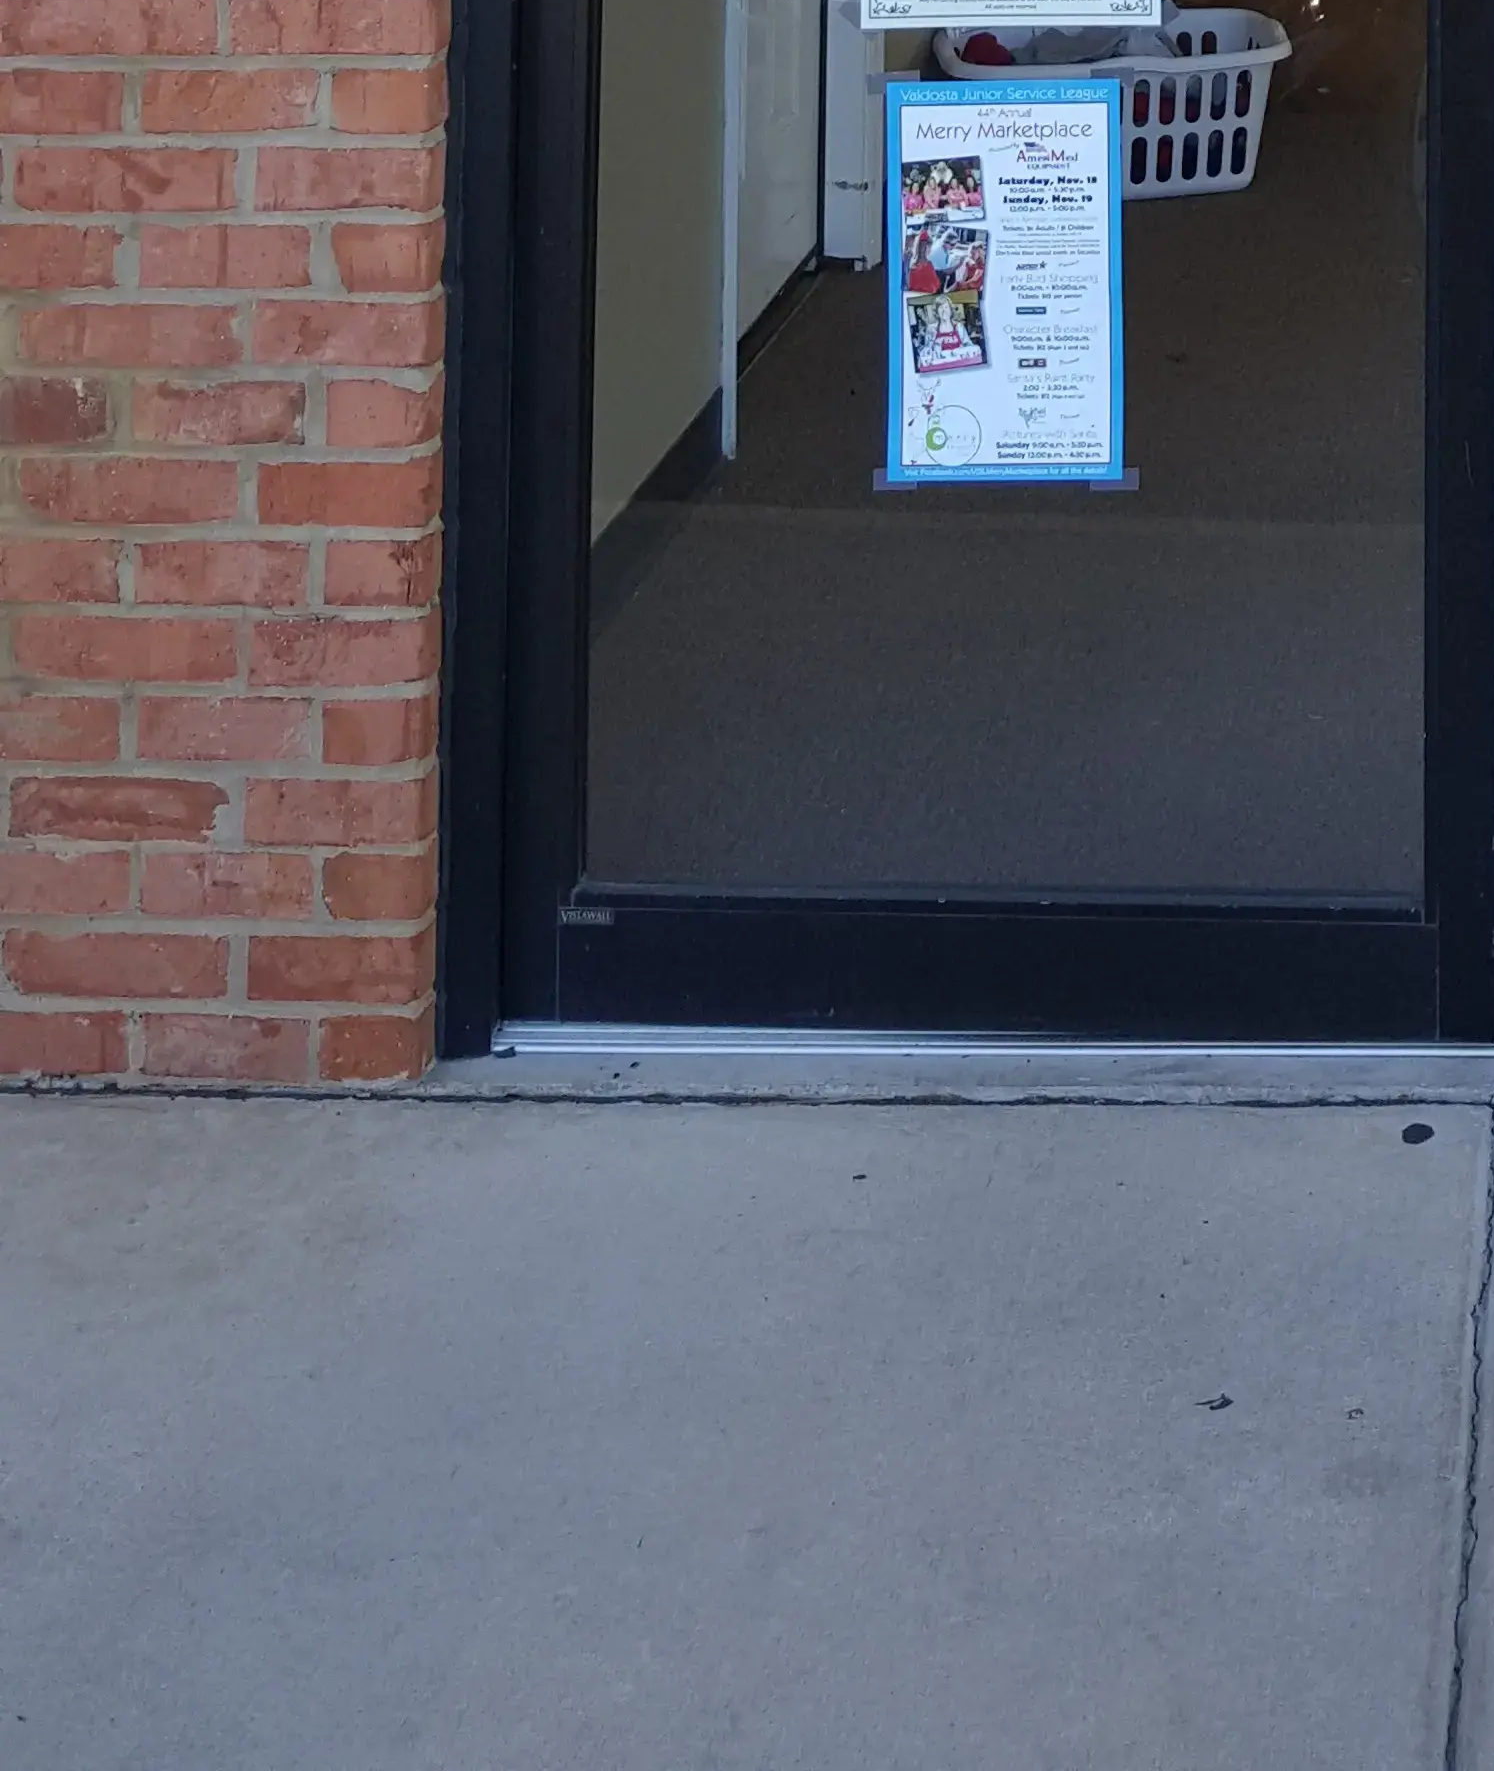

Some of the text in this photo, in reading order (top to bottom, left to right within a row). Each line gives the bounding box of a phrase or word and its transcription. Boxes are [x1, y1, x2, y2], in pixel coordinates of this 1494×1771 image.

[901, 86, 1109, 102] Valdosta Junior Service League
[916, 120, 1093, 143] Merry Marketplace
[998, 176, 1098, 186] Saturday, Nov. 18
[1003, 194, 1093, 205] Sunday, Nov. 19
